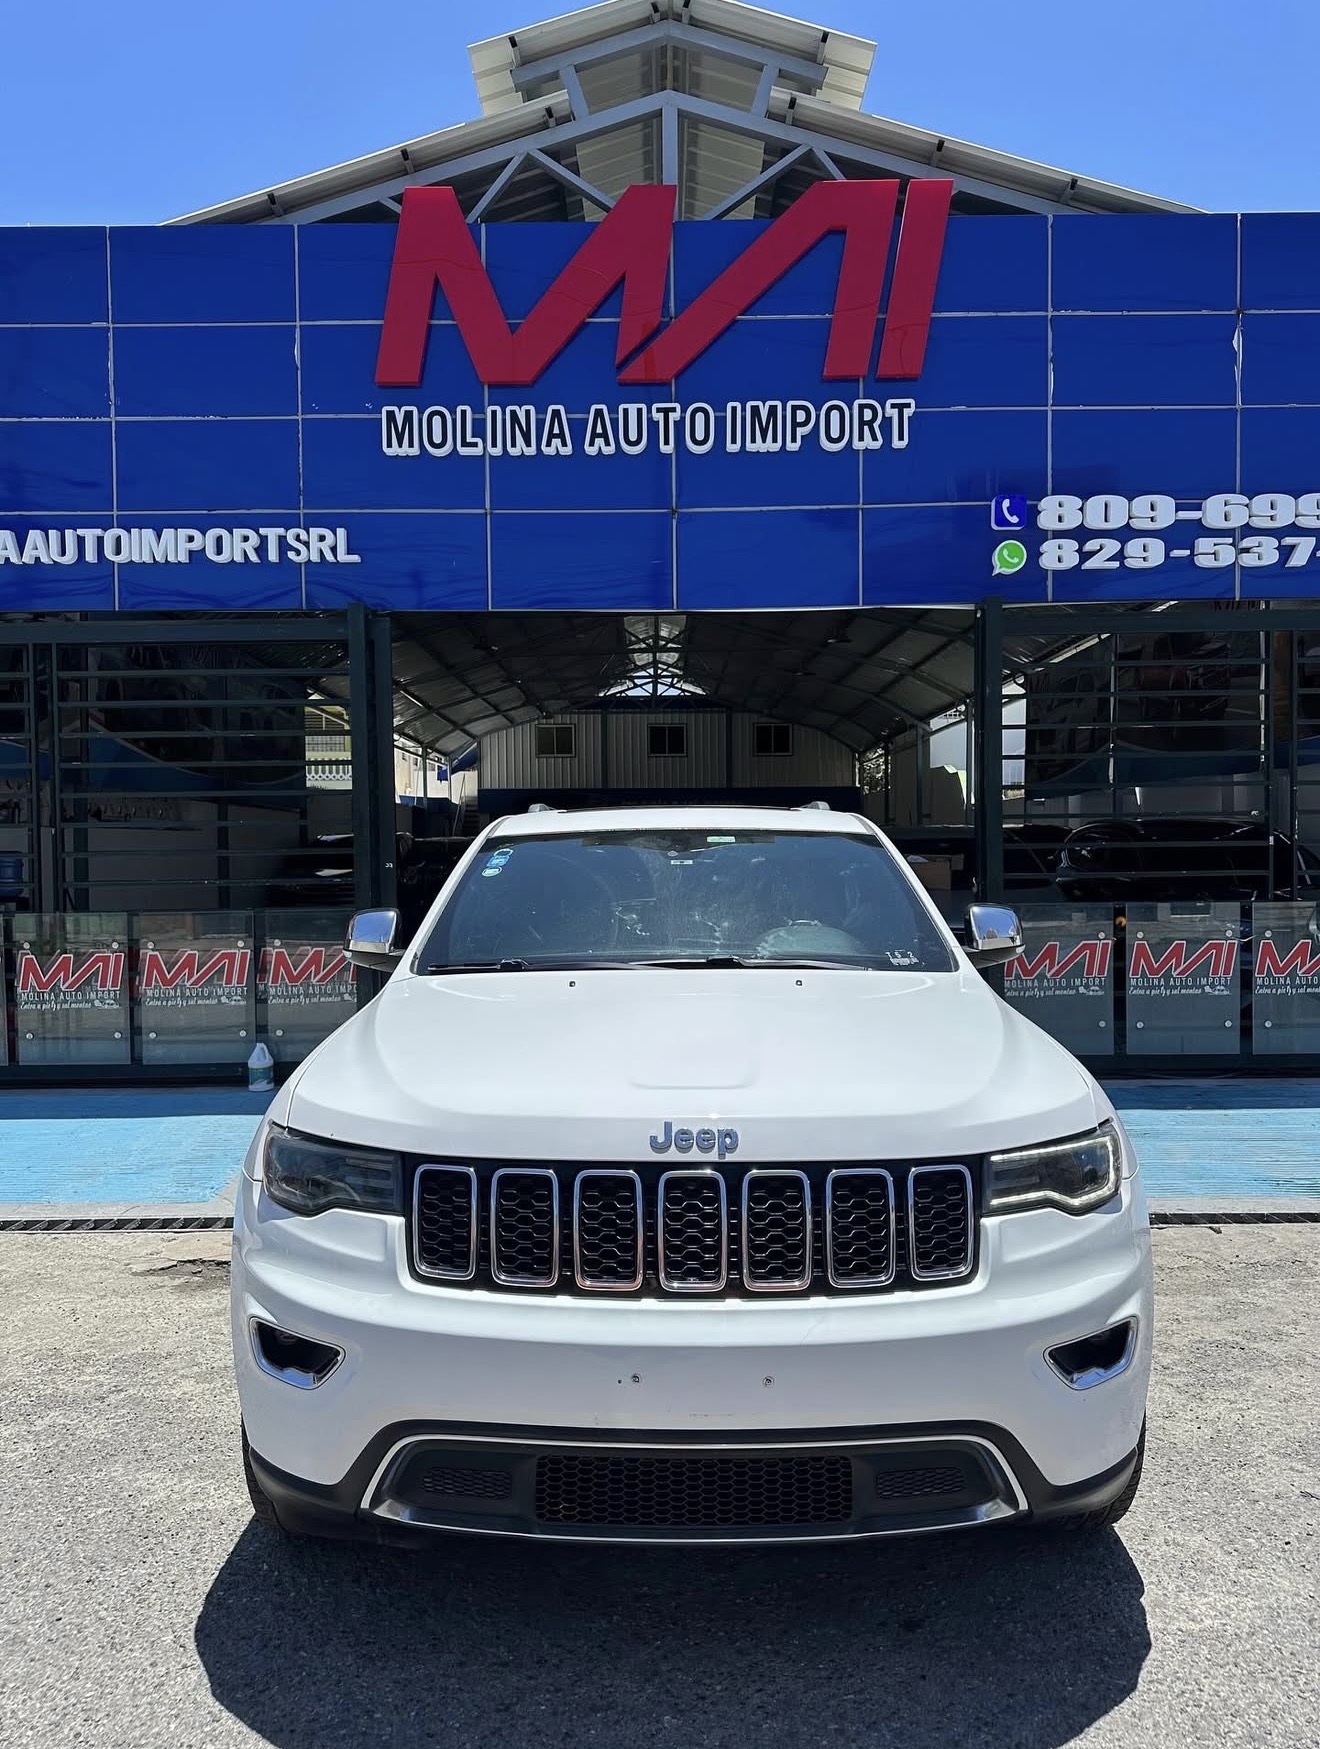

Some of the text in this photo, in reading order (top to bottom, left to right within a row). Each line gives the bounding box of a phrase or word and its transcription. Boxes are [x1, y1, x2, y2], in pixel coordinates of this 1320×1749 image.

[374, 179, 954, 387] MAI
[382, 399, 916, 456] MOLINA AUTO IMPORT
[0, 528, 362, 565] AAUTOIMPORTSRL
[1038, 536, 1320, 571] 829-537
[20, 953, 124, 992] MAI
[143, 949, 250, 989] MAI
[1004, 940, 1112, 979] MAI
[1129, 940, 1238, 977] MAI
[21, 990, 120, 1001] MOLINA AUTO IMPORT
[146, 987, 248, 997] MOLINA AUTO IMPORT
[269, 987, 305, 995] MOLINA
[308, 985, 332, 994] AUTO
[1004, 977, 1106, 988] MOLINA AUTO IMPORT
[1130, 977, 1231, 986] MOLINA AUTO IMPORT
[1256, 976, 1319, 985] MOLINA AUTO
[649, 1121, 739, 1160] Jeep
